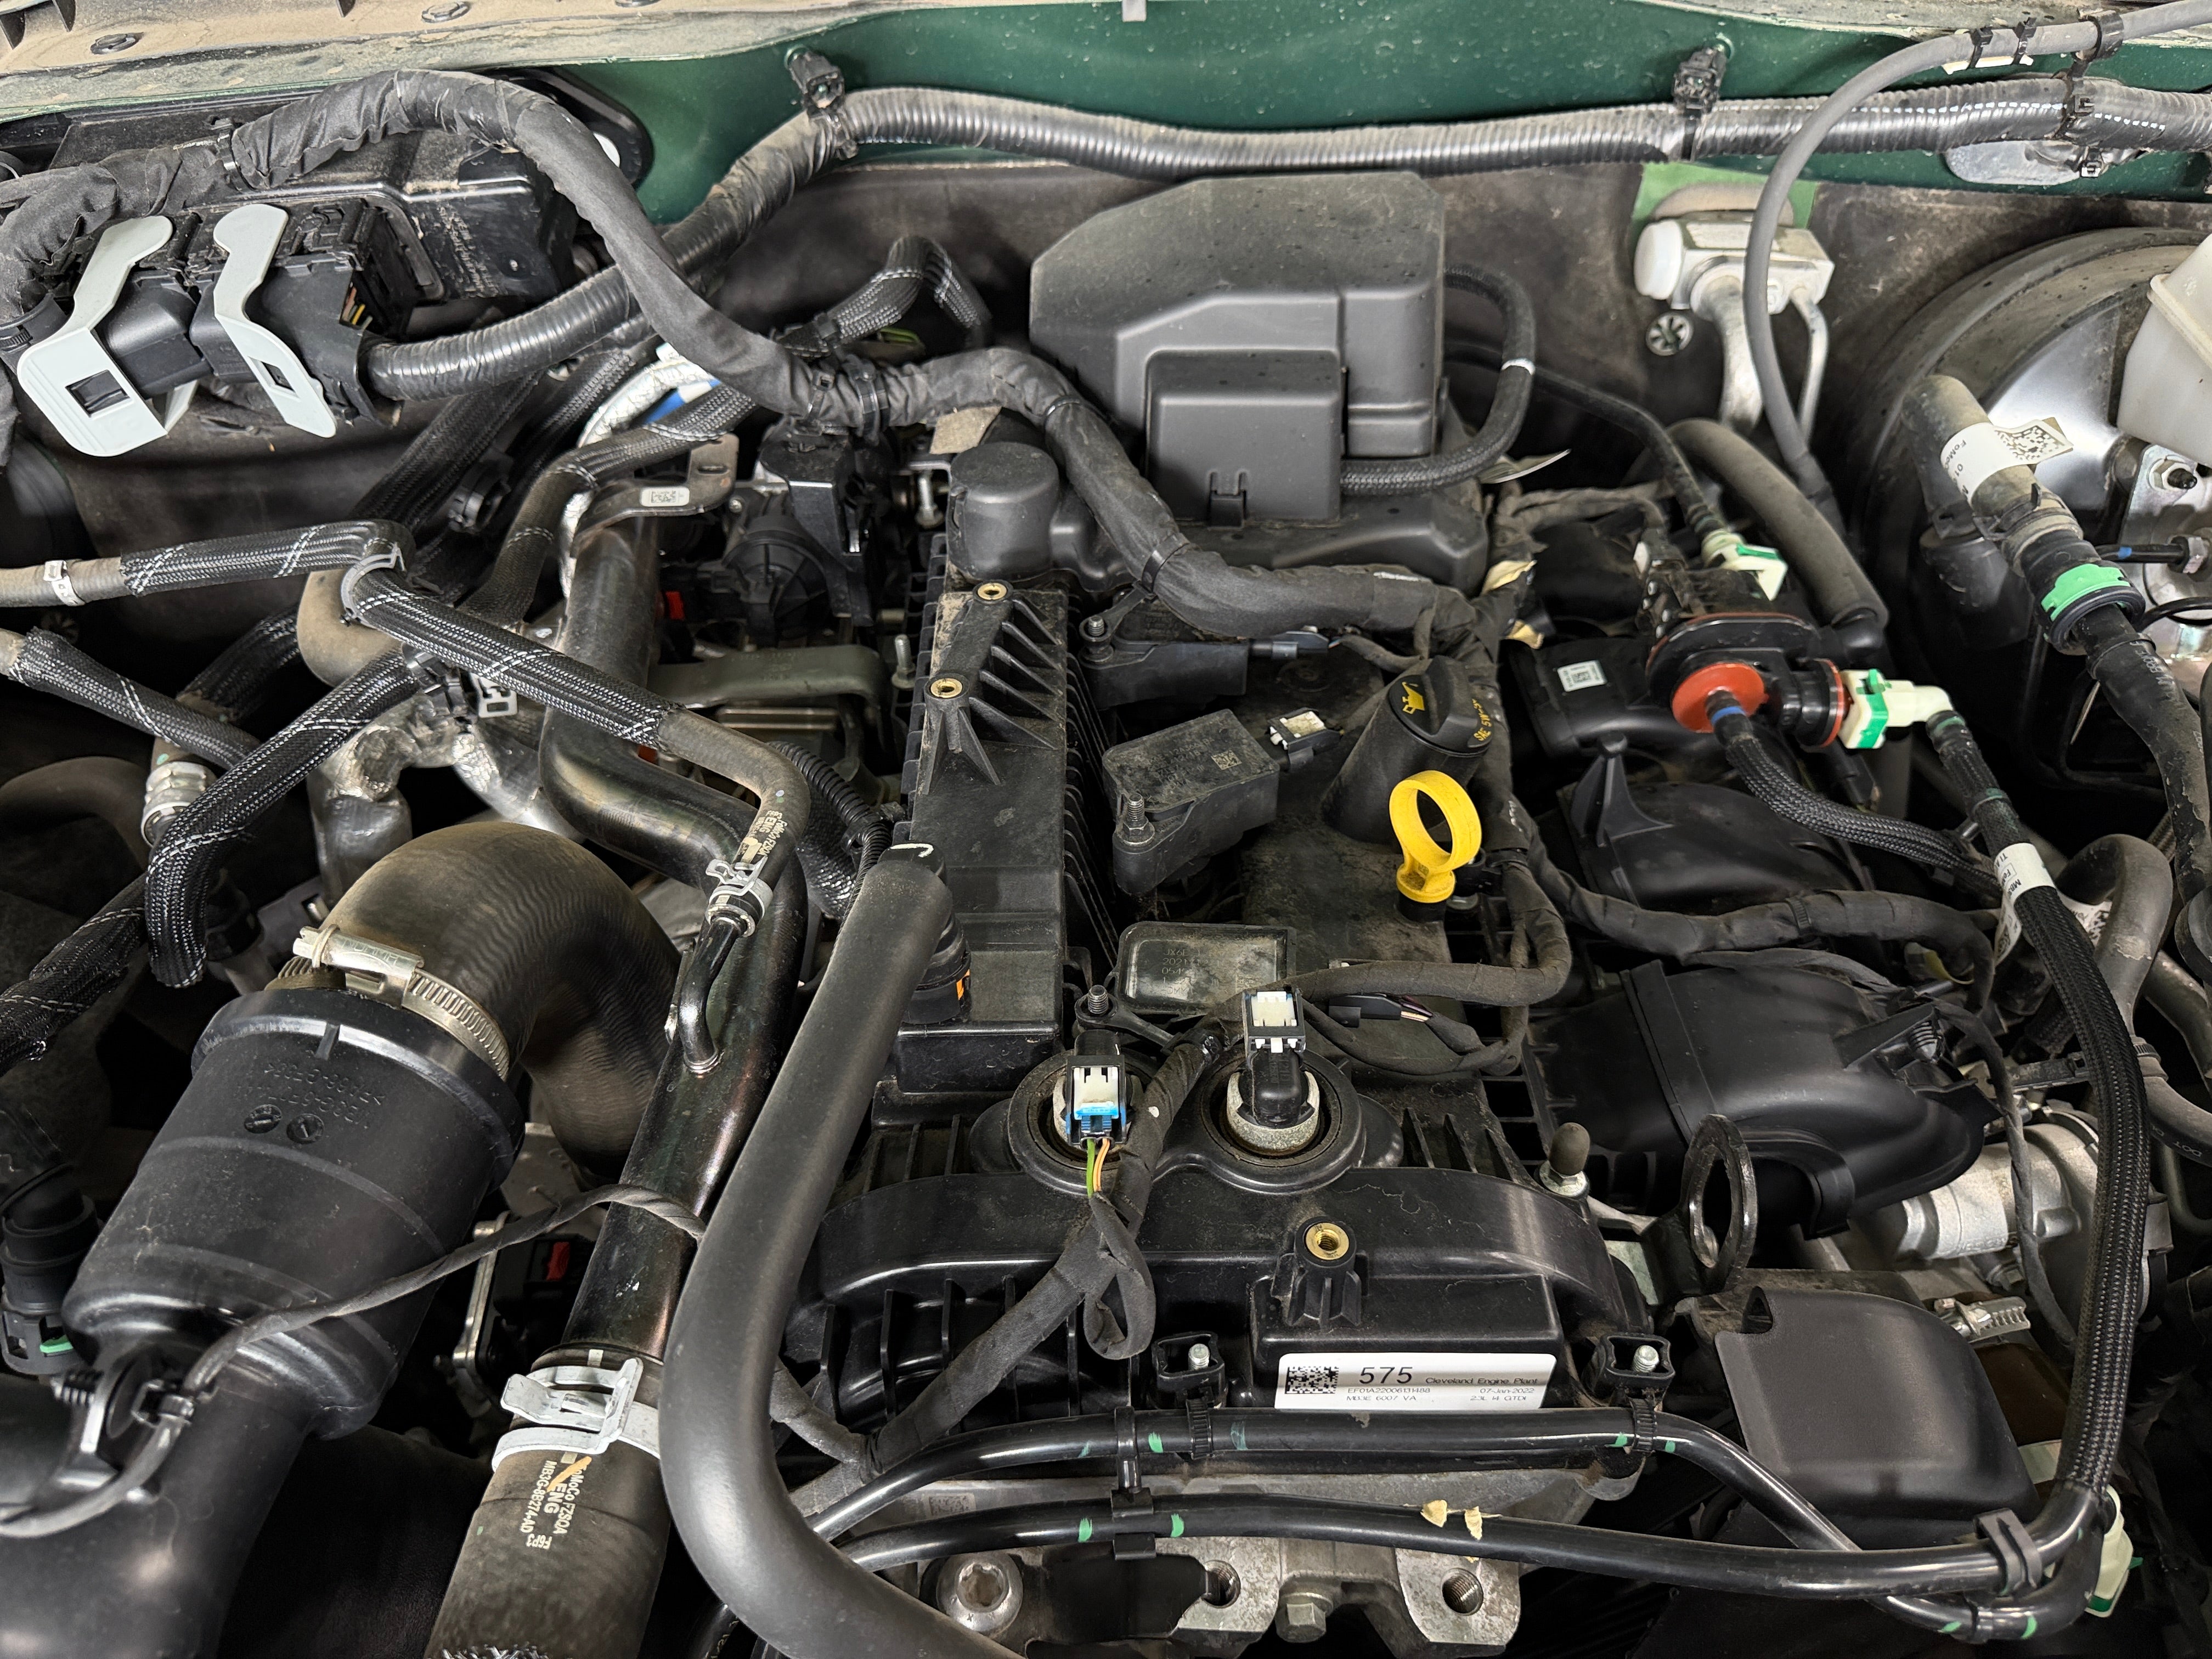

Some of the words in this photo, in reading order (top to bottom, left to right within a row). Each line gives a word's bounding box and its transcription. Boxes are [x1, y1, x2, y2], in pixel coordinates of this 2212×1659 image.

[1474, 727, 1492, 742] SAE
[759, 817, 777, 833] ENG
[1359, 1367, 1413, 1384] 575
[520, 1460, 558, 1533] MB3G-8B274-AD
[544, 1483, 568, 1514] ENG
[553, 1502, 576, 1534] FZSQA
